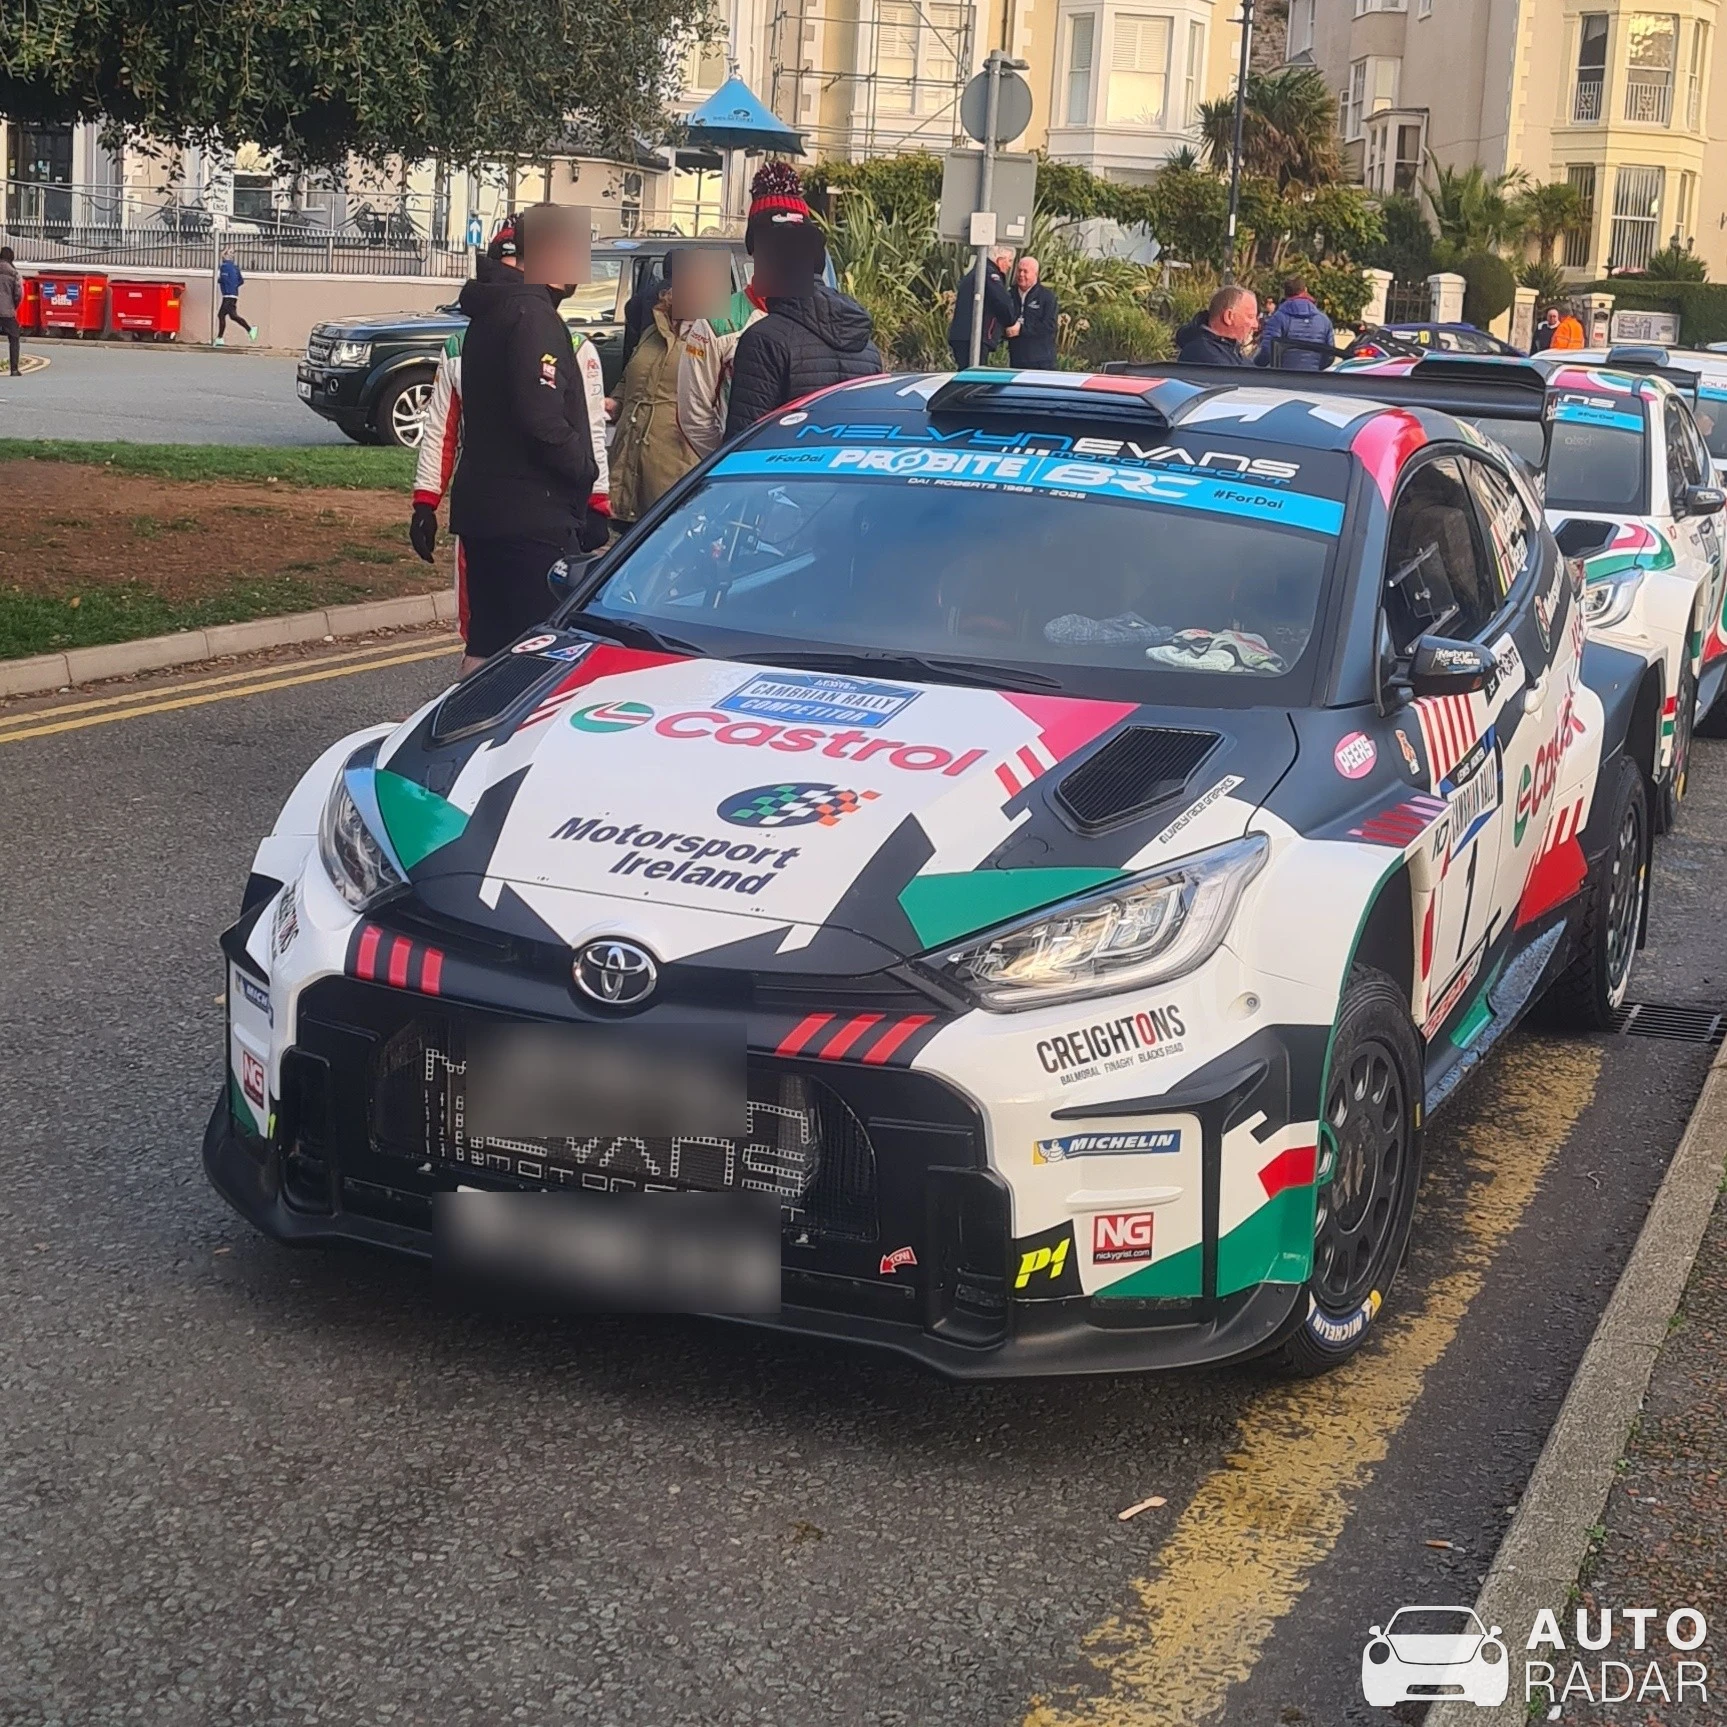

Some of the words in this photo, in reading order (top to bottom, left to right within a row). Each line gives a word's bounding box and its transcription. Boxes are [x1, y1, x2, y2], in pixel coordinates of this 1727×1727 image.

[765, 453, 823, 464] #ForDai
[828, 447, 1031, 477] PROBITE
[1041, 463, 1203, 499] BRC
[1213, 489, 1284, 510] #ForDai
[907, 477, 930, 485] DAI
[934, 478, 997, 490] ROBERTS
[1049, 489, 1087, 500] 2025
[739, 699, 869, 722] COMPETITOR
[750, 682, 843, 703] CAMBRIAN
[841, 690, 898, 709] RALLY
[654, 710, 988, 776] Castrol
[548, 816, 801, 869] Motorsport
[609, 849, 777, 896] Ireland
[1036, 1004, 1186, 1074] CREIGHTONS
[1060, 1066, 1101, 1086] BALMORAL
[1104, 1056, 1134, 1073] FINAGHY
[1138, 1047, 1165, 1063] BLACKS
[1165, 1043, 1184, 1056] ROAD
[1069, 1134, 1174, 1152] MICHELIN
[1097, 1215, 1152, 1248] NG
[890, 1250, 910, 1264] TOW
[1014, 1238, 1071, 1289] P1
[1096, 1249, 1150, 1262] nickygrist.com
[1312, 1313, 1363, 1341] MICHELIN
